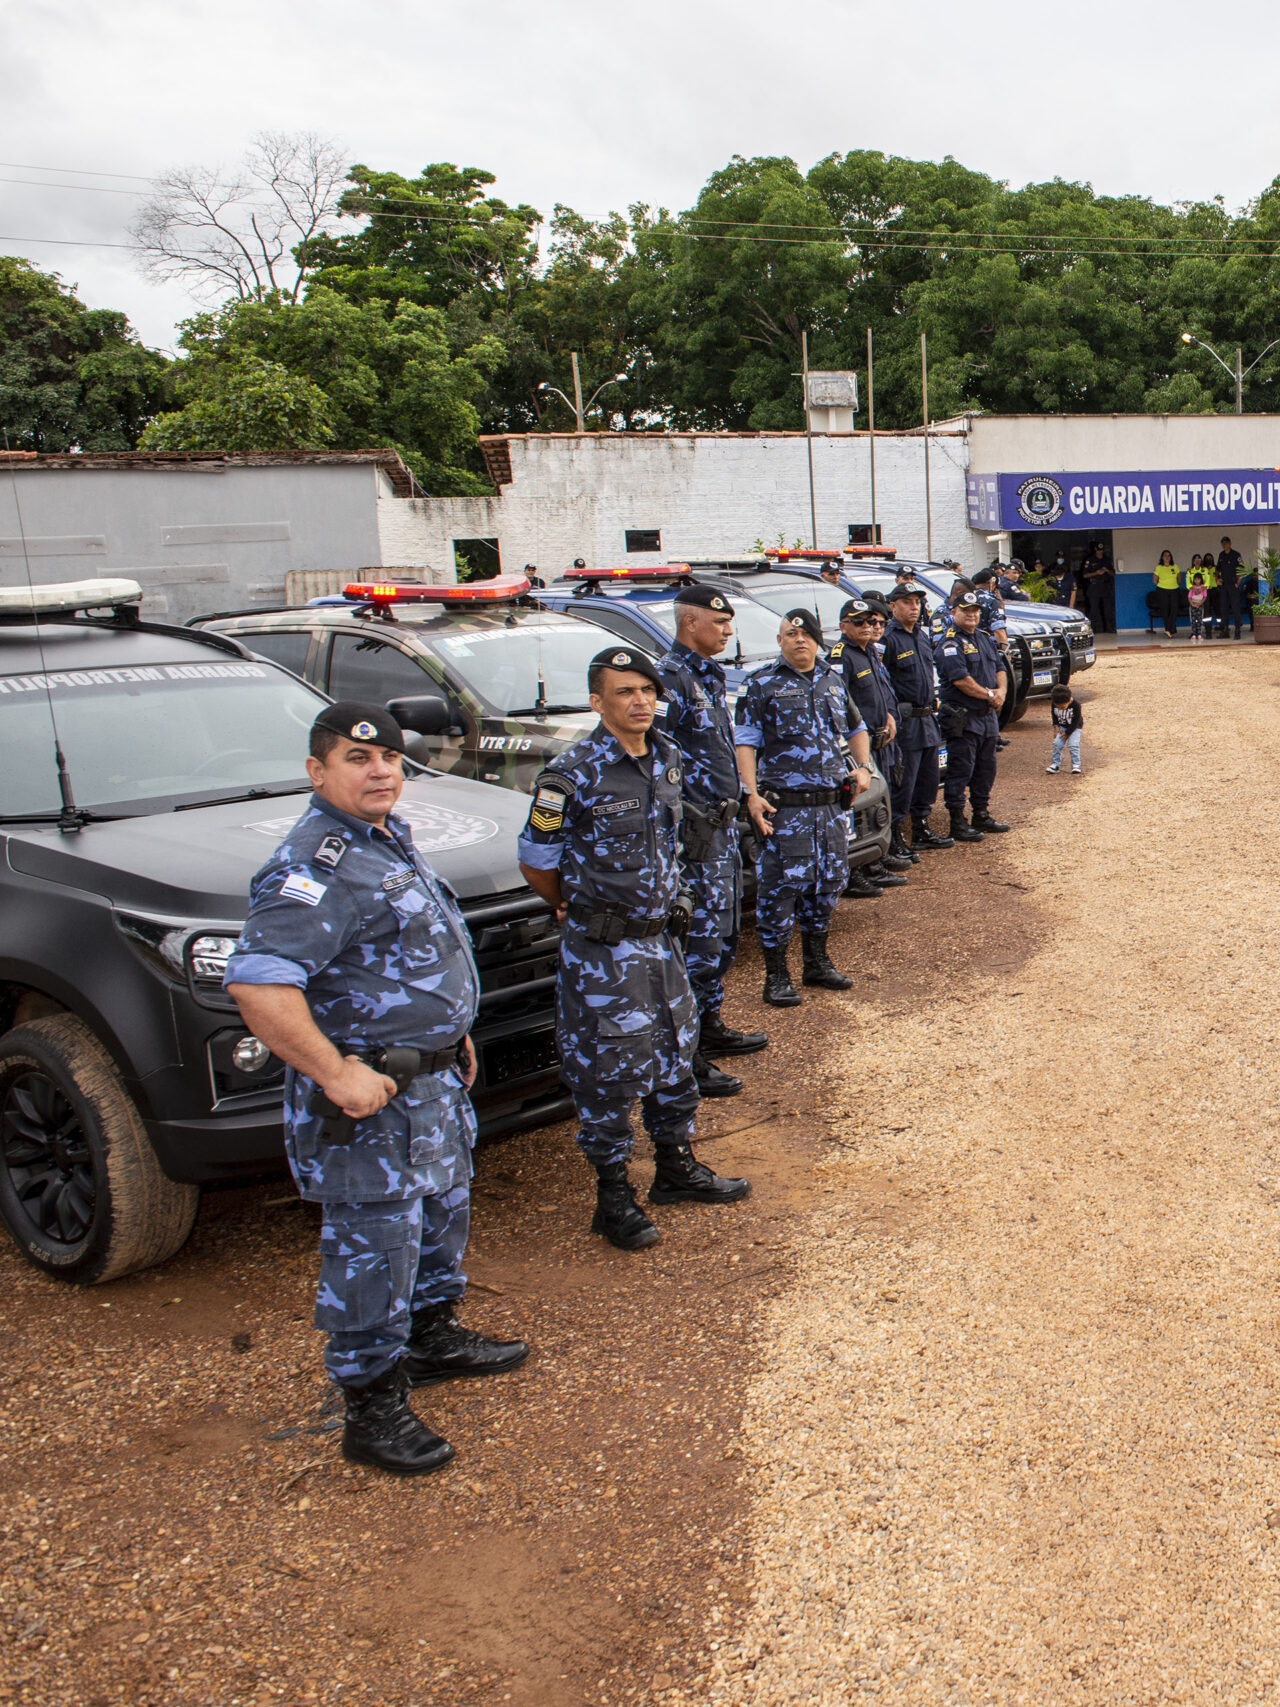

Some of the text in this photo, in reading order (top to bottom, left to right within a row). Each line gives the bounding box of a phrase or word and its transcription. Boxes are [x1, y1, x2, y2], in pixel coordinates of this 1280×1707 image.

[1070, 485, 1155, 515] GUARDA
[479, 736, 533, 751] VTR 113
